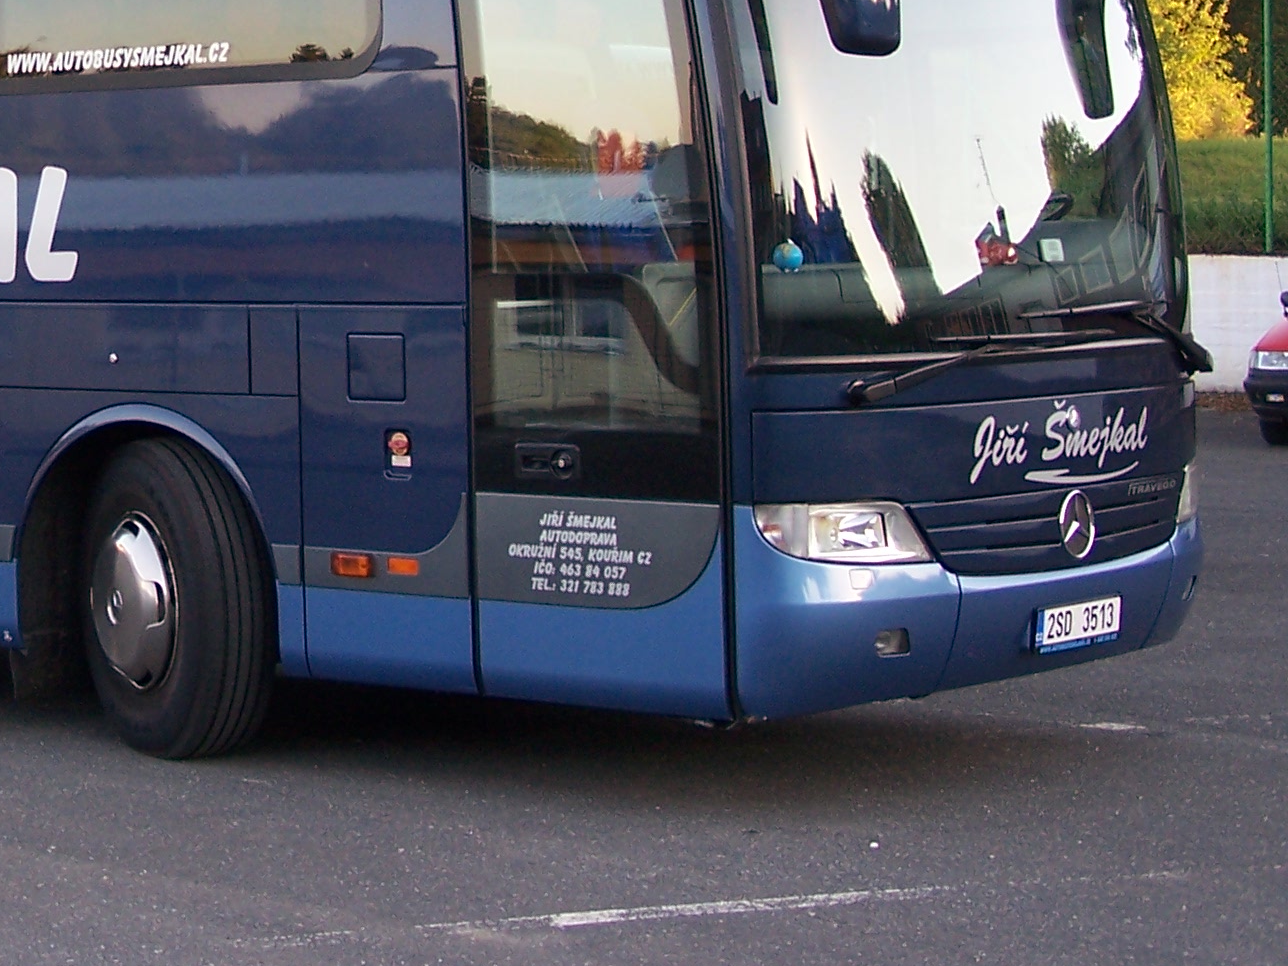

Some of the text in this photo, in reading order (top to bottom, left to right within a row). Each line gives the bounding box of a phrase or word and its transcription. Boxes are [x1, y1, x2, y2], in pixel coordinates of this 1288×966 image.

[7, 42, 230, 74] WWW.AUTOBUSYSMEJKAL.CZ
[970, 400, 1148, 484] Jiří Šmejkal
[539, 510, 617, 530] JIŘÍ ŠMEJKAL
[539, 530, 617, 546] AUTODOPRAVA
[508, 542, 557, 559] OKRUŽNÍ
[637, 551, 652, 565] CZ
[560, 564, 582, 577] 463
[604, 566, 627, 580] 057
[560, 579, 579, 593] 321
[1047, 602, 1114, 639] 2SD 3513
